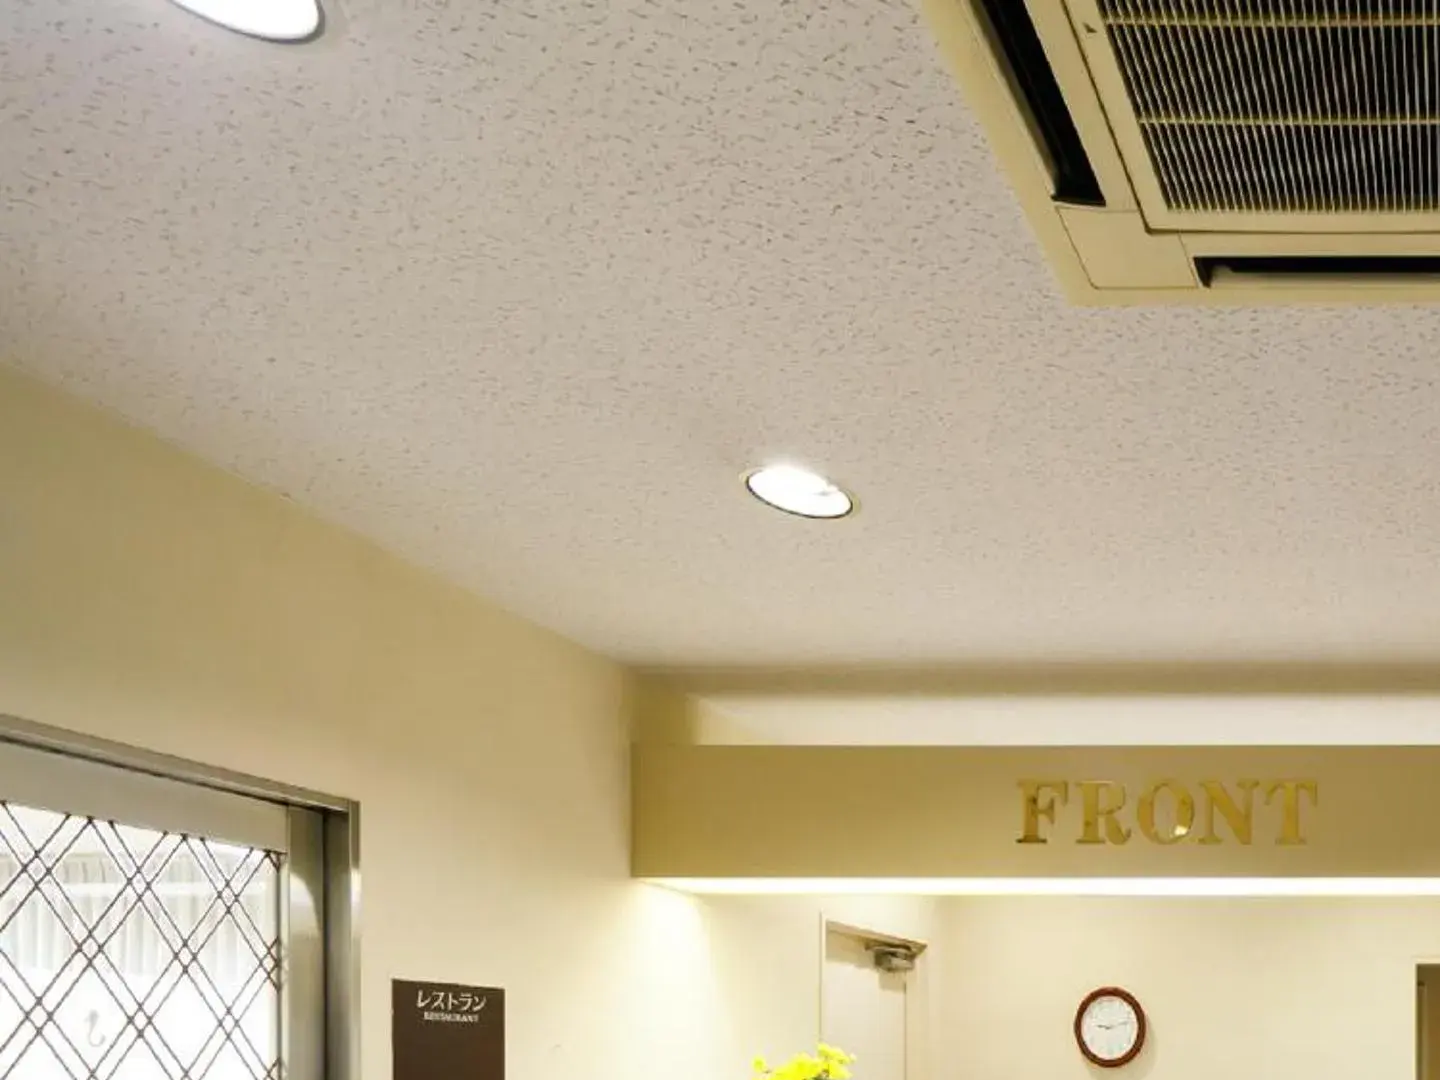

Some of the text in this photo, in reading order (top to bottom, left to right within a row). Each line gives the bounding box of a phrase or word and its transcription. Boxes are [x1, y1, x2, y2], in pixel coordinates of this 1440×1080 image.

[1015, 778, 1319, 846] FRONT
[416, 989, 487, 1012] レストラン
[424, 1011, 479, 1023] RESTAURANT
